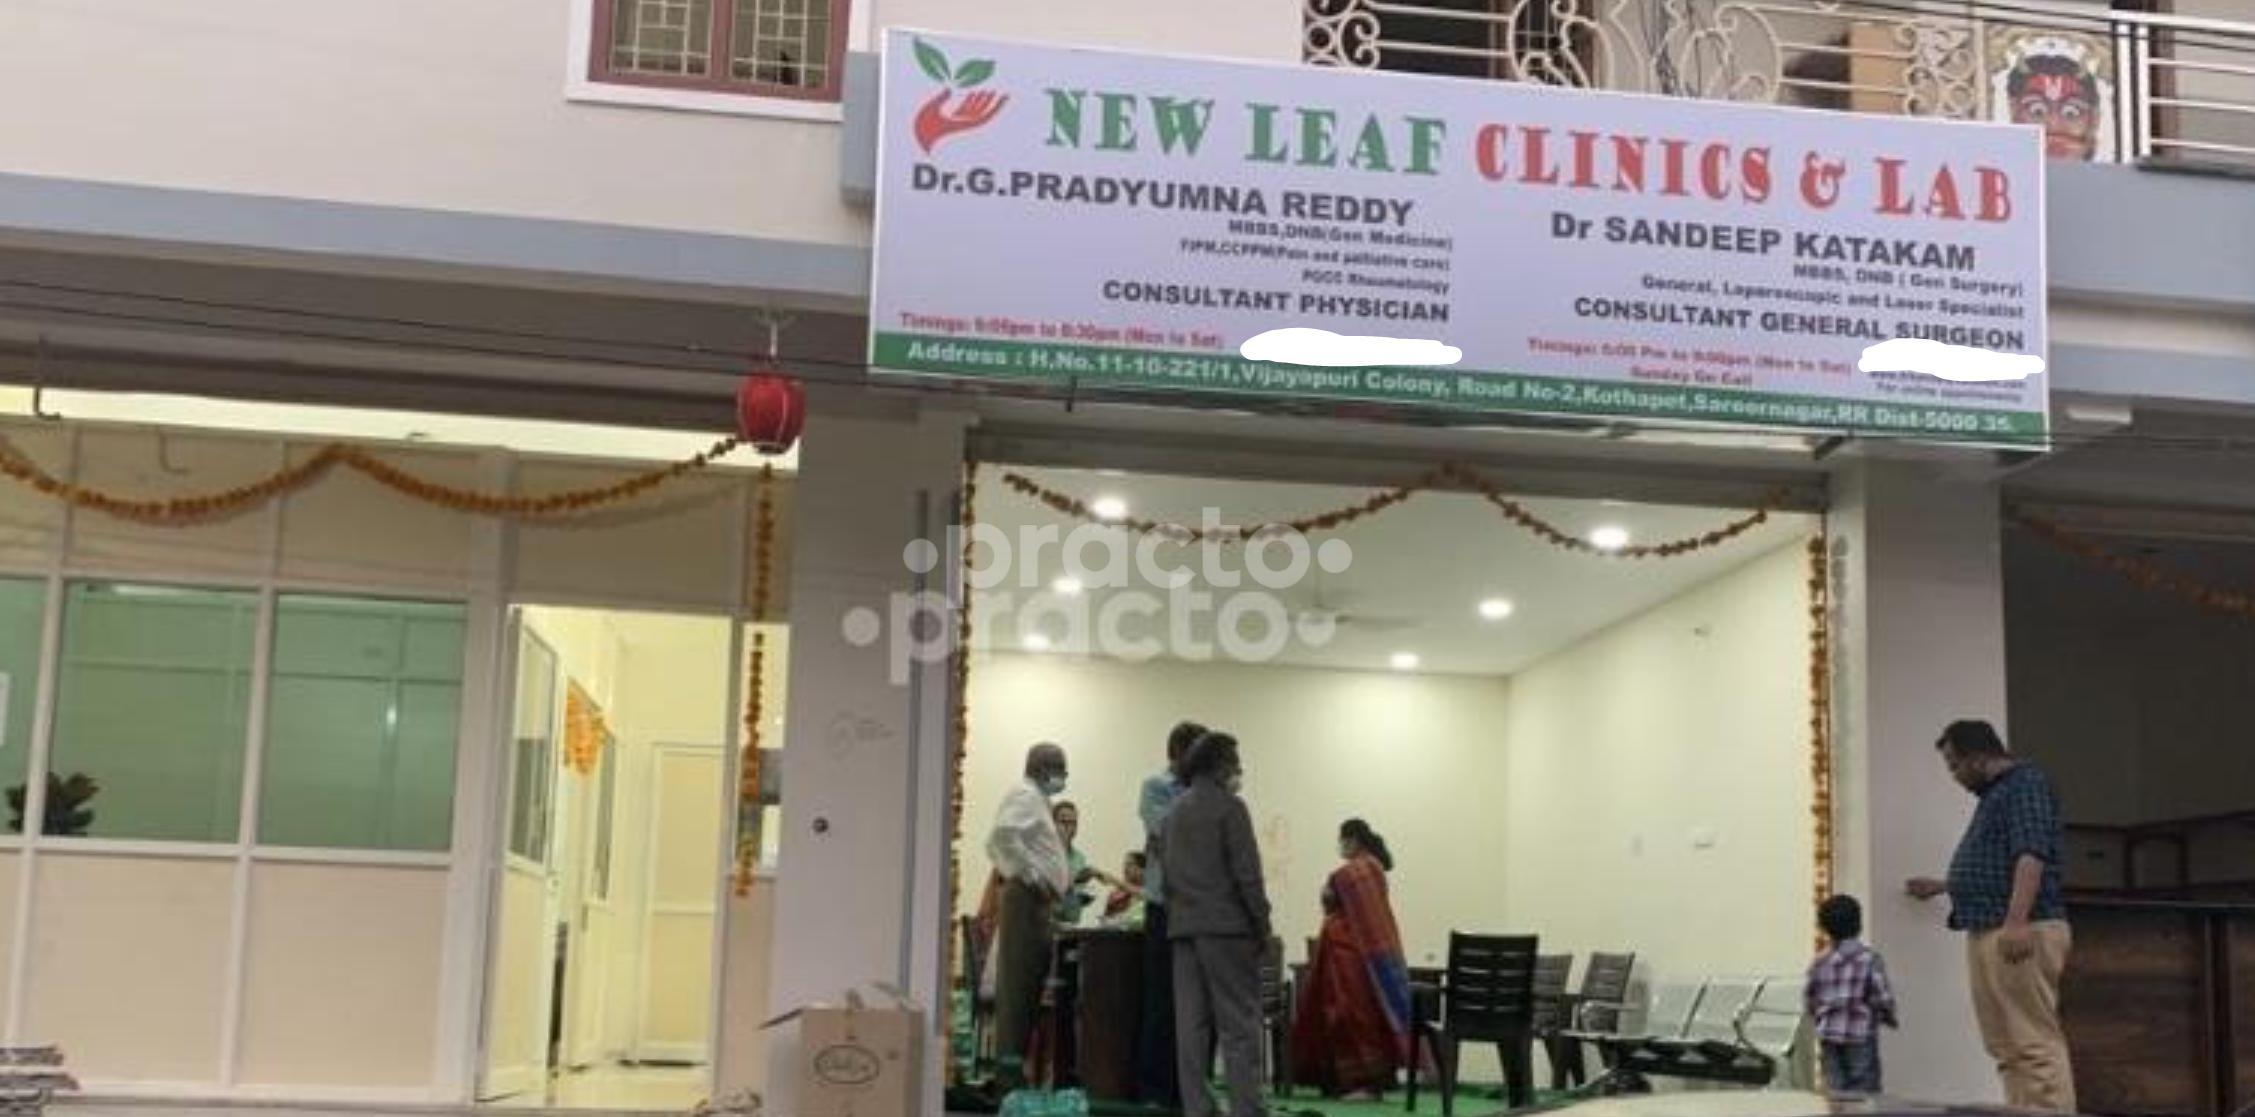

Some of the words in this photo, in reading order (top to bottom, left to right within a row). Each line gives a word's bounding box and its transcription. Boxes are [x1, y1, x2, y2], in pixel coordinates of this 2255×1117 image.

[1045, 88, 1215, 156] NEW
[1244, 103, 1447, 174] LEAF
[1475, 122, 1773, 204] CLINICS
[1800, 152, 1846, 208] &
[1874, 157, 2012, 223] LAB
[912, 163, 1267, 215] Dr.G.PRADYUMNA
[1282, 191, 1415, 227] REDDY
[1551, 212, 1593, 243] Dr
[1604, 215, 1782, 255] SANDEEP
[1795, 232, 1976, 273] KATAKAM
[1103, 279, 1291, 312] CONSULTANT
[1299, 293, 1450, 323] PHYSICIAN
[1573, 296, 1753, 331] CONSULTANT
[1761, 311, 1888, 341] GENERAL
[1894, 319, 2025, 350] SURGEON
[1847, 291, 1879, 309] and
[1938, 296, 2025, 320] Specialist
[908, 341, 1007, 366] Address
[1365, 370, 1450, 397] Colony,
[1457, 376, 1517, 397] Road
